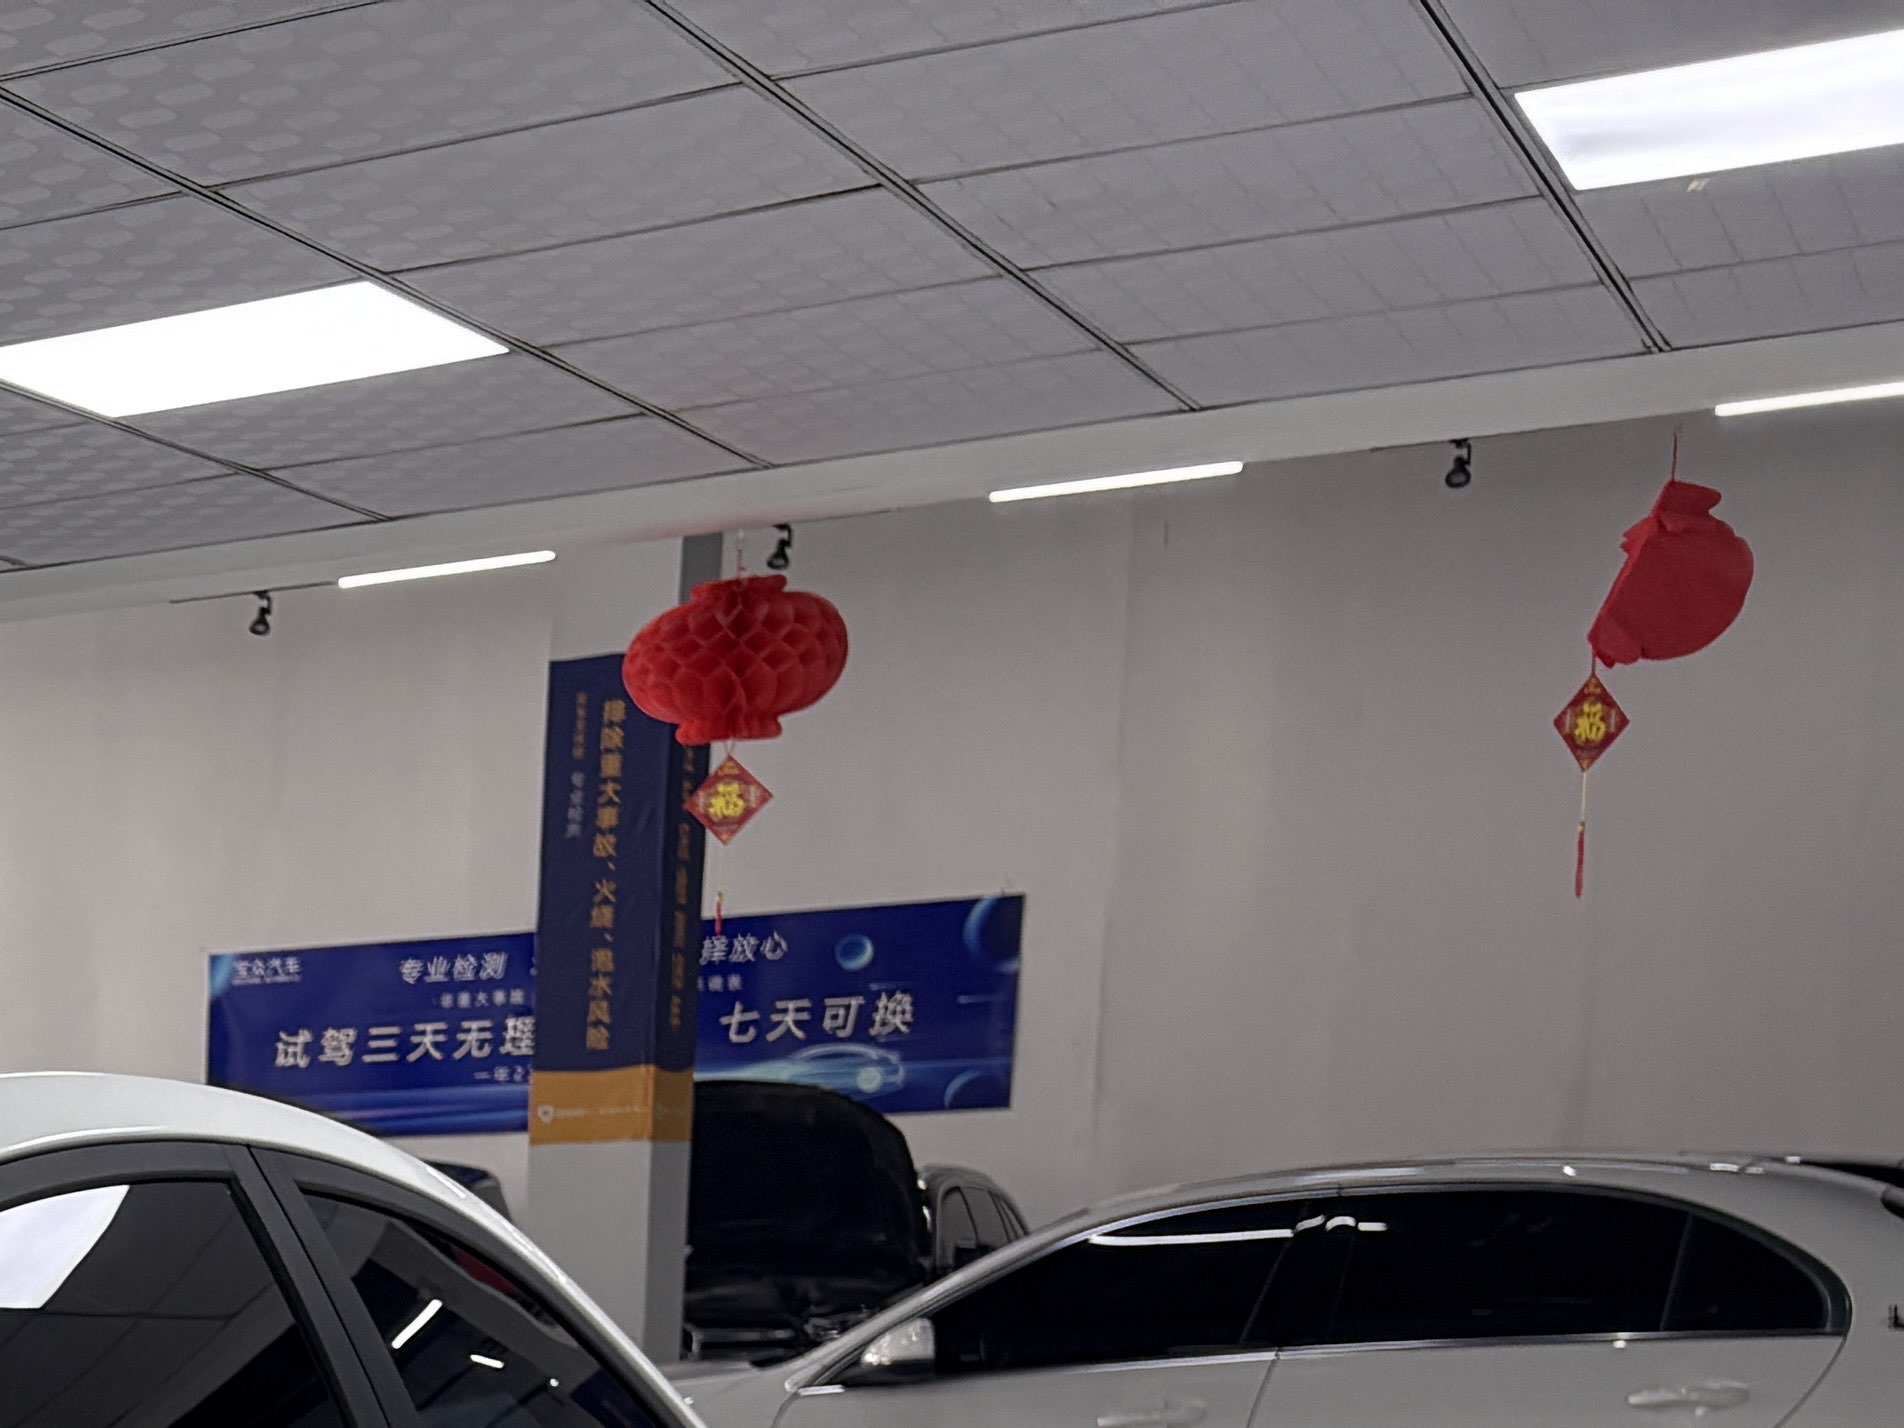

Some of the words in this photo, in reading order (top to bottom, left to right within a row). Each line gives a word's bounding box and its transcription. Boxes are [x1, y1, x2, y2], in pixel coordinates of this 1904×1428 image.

[709, 782, 747, 819] 福
[399, 952, 509, 985] 专业检测
[274, 1014, 536, 1068] 试驾三天无理
[719, 991, 915, 1044] 七天可换
